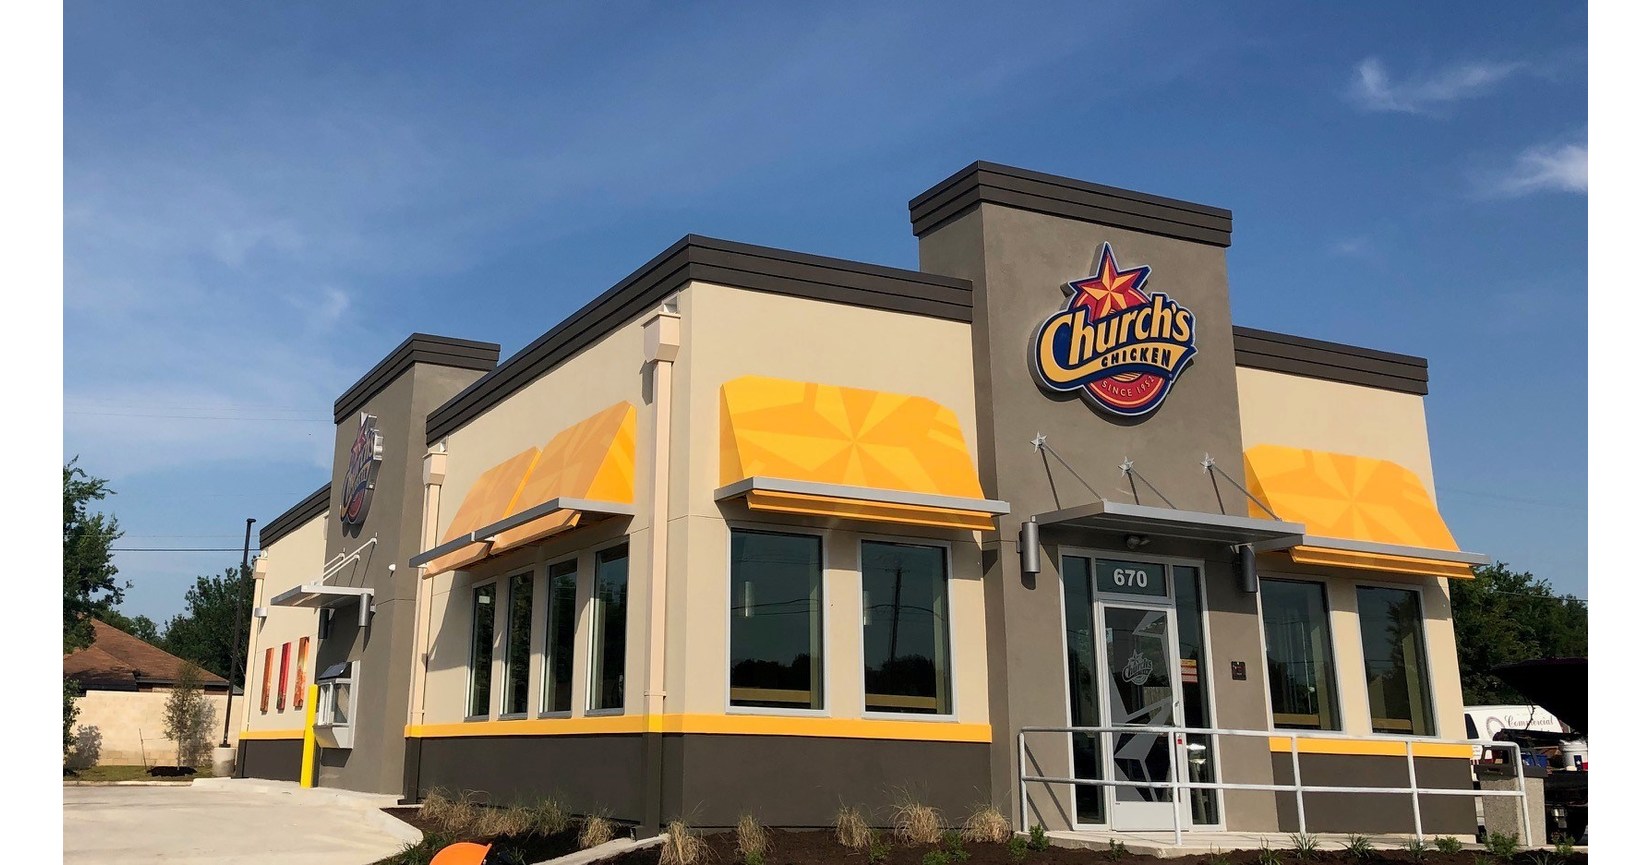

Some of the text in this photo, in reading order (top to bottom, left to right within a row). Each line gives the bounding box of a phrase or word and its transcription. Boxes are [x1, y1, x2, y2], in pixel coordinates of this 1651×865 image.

[1040, 296, 1190, 382] Church's
[1101, 347, 1171, 367] CHICKEN
[1101, 375, 1155, 397] SINCE 1952
[1113, 568, 1148, 588] 670
